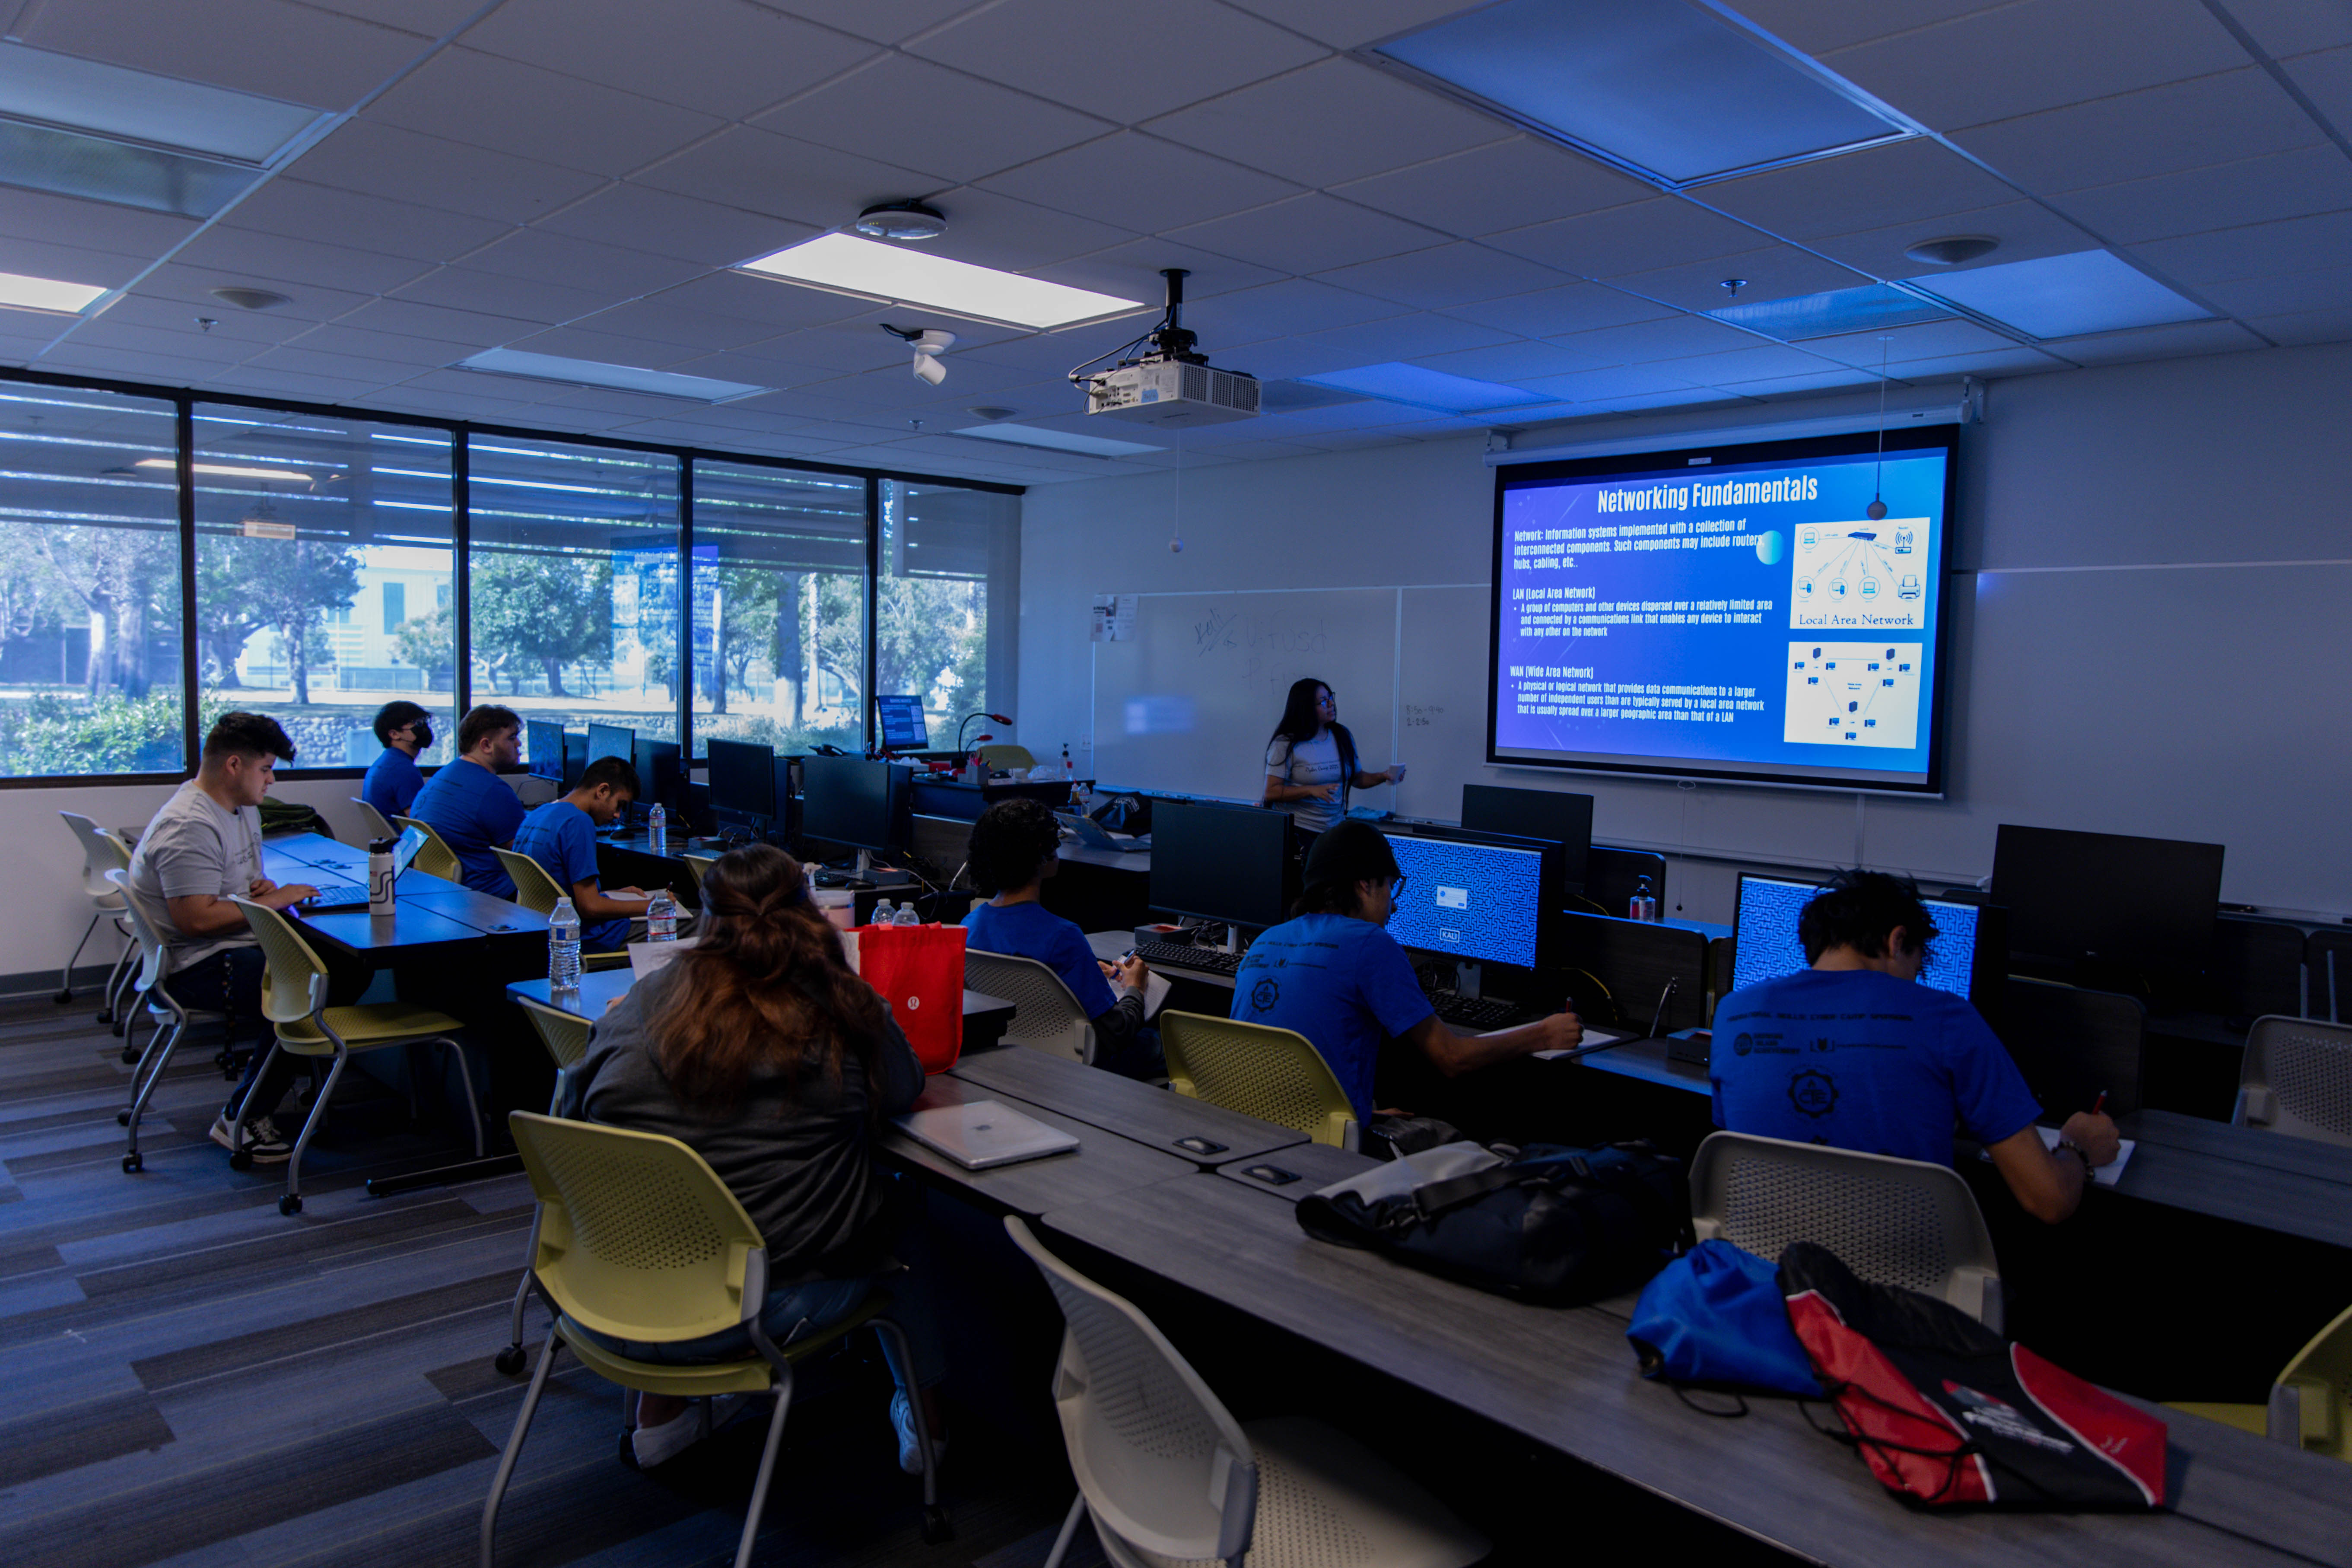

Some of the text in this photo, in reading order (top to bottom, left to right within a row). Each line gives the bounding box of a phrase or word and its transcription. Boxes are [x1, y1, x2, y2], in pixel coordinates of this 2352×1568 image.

[1599, 475, 1817, 512] Networking Fundamentals
[1515, 518, 1745, 541] Network: Information systems implemented with a collection of
[1515, 535, 1764, 555] interconnected components. Such components may include routers,
[1514, 558, 1531, 570] hubs,
[1534, 557, 1560, 569] cabling,
[1513, 587, 1595, 600] LAN (Local Area Network)
[1521, 600, 1772, 613] A group of computers and other devices dispersed over a relatively limited area
[1521, 615, 1531, 624] and
[1533, 615, 1562, 624] connected
[1565, 615, 1571, 625] by
[1579, 614, 1629, 624] communications
[1631, 614, 1643, 623] link
[1645, 614, 1658, 623] that
[1660, 614, 1685, 623] enables
[1687, 614, 1699, 624] any
[1701, 614, 1722, 623] device
[1725, 614, 1731, 623] to
[1734, 613, 1761, 623] interact
[1799, 613, 1914, 625] Local Area Network
[1521, 627, 1607, 637] with any other on the network
[1510, 666, 1593, 679] WAN (Wide Area Network)
[1518, 681, 1522, 690] A
[1524, 682, 1546, 691] physical
[1556, 682, 1576, 692] logical
[1578, 683, 1602, 692] network
[1604, 683, 1615, 692] that
[1618, 684, 1644, 694] provides
[1646, 684, 1660, 694] data
[1662, 685, 1717, 696] communications
[1719, 686, 1726, 696] to
[1728, 687, 1732, 696] a
[1735, 687, 1755, 697] larger
[1518, 693, 1764, 710] number of independent users than are typically served by a local area network
[1518, 705, 1733, 722] that is usually spread over a larger geographic area than that of a LAN
[1442, 931, 1458, 940] KALI
[1798, 1088, 1828, 1106] CTE
